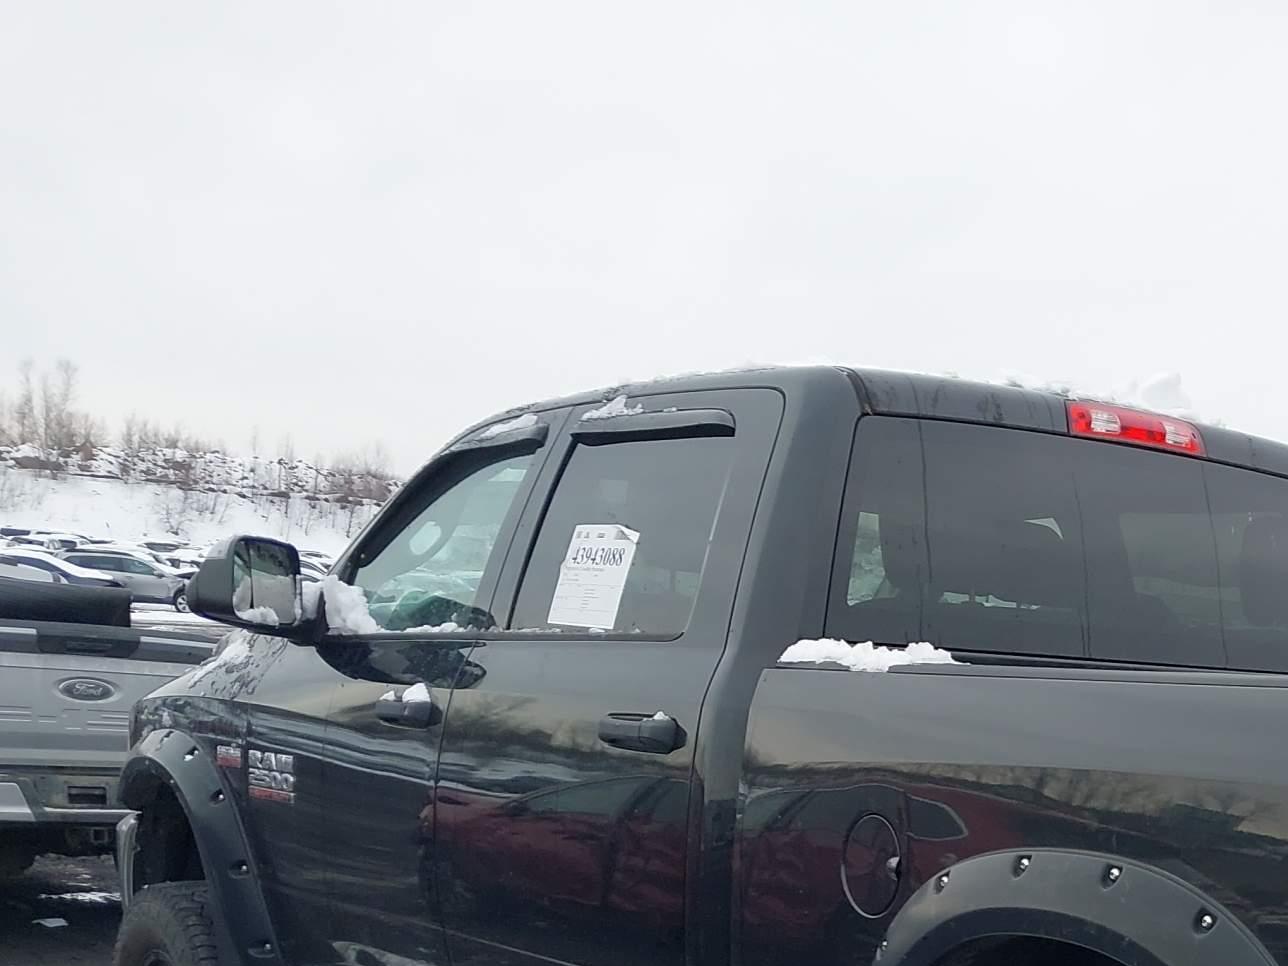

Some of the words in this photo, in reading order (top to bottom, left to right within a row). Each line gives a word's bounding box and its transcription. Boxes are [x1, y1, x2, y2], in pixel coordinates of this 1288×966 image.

[572, 547, 625, 566] 43943088
[72, 682, 103, 696] Ford
[248, 750, 294, 772] RAM
[248, 768, 296, 791] 2500
